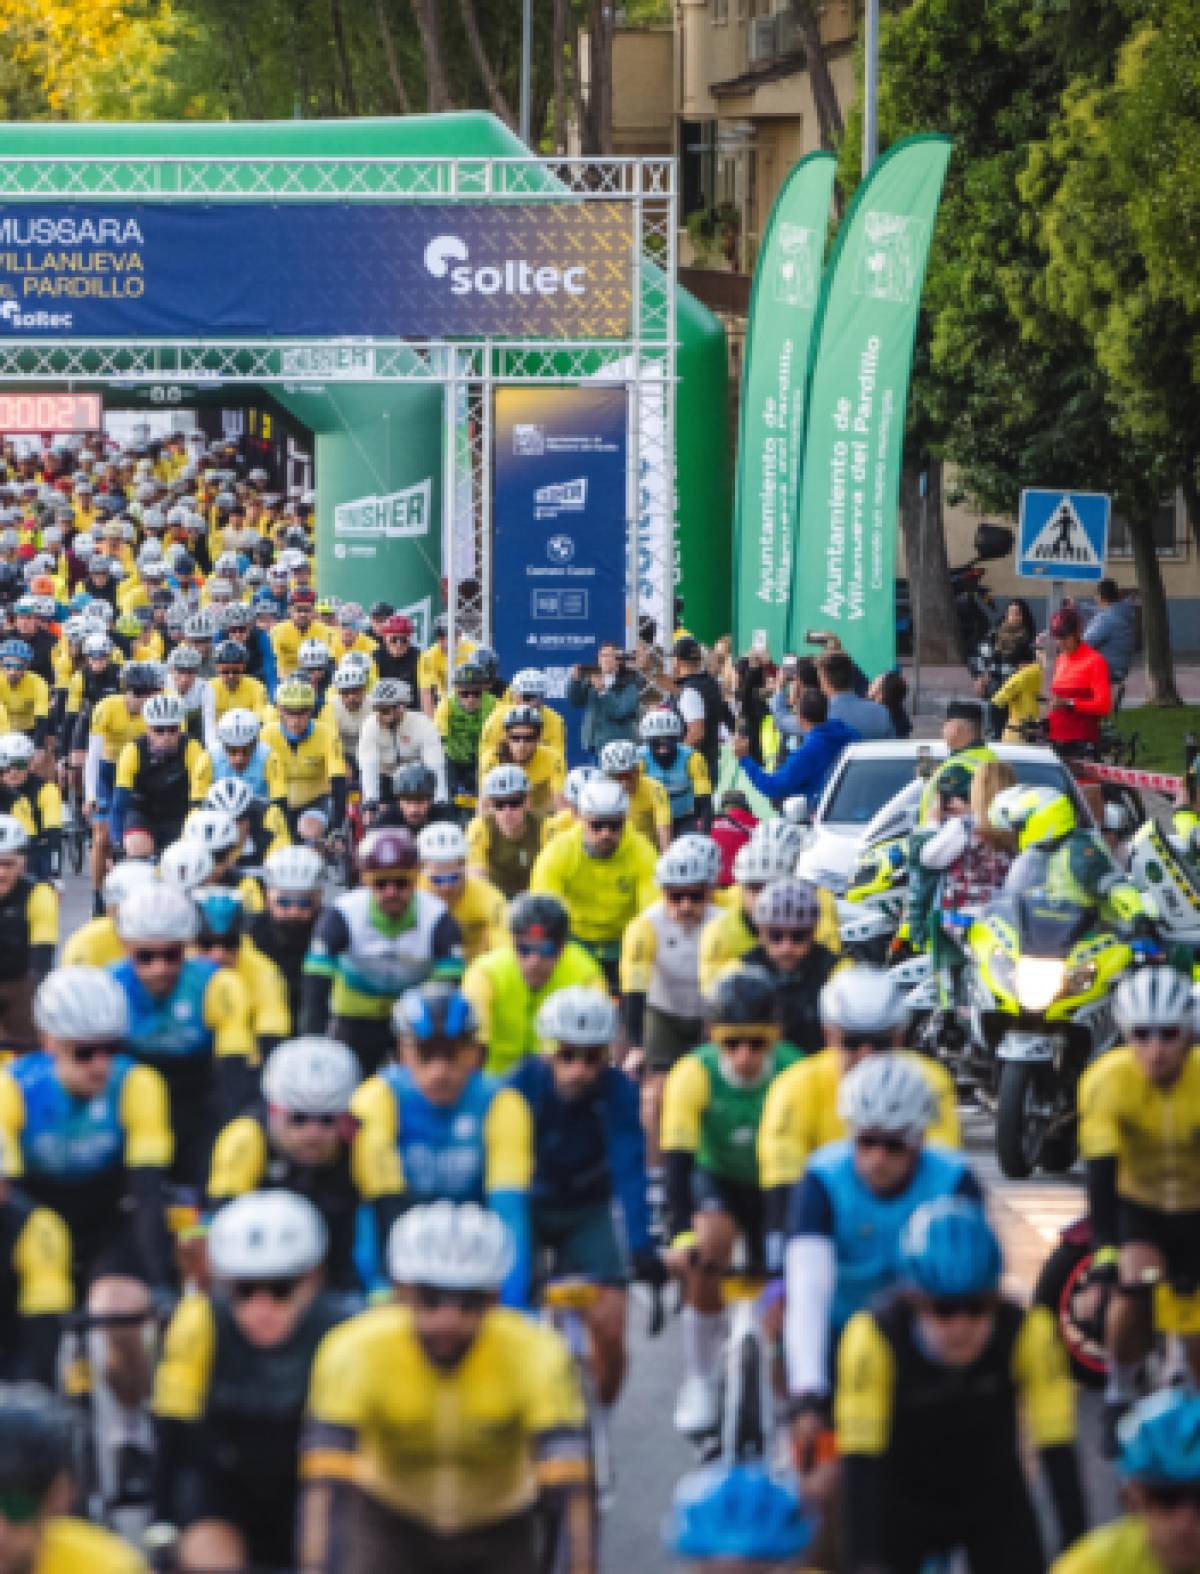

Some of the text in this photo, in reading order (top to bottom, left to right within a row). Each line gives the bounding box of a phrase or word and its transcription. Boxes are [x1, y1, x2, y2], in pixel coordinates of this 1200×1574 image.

[23, 276, 144, 298] PARDILLO
[450, 259, 586, 295] soltec
[754, 397, 778, 603] Ayuntamiento de
[820, 396, 852, 620] Ayuntamiento de
[847, 335, 881, 620] Villanueva del Pardillo
